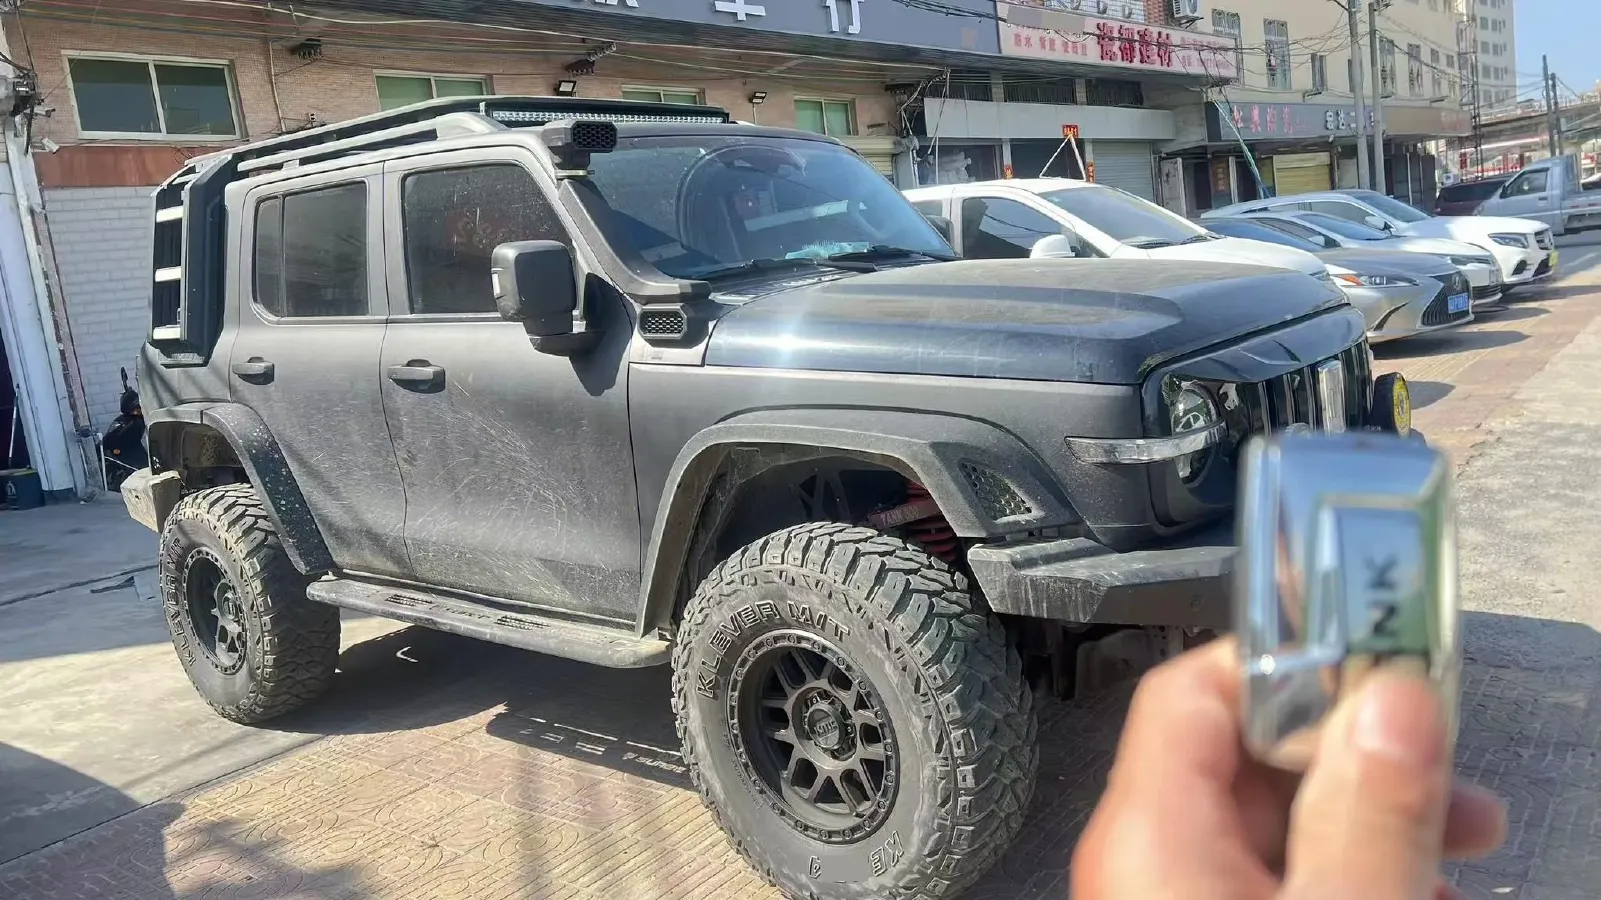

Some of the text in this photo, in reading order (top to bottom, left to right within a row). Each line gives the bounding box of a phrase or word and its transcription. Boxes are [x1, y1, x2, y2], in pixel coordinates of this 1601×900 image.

[880, 508, 903, 527] TANK
[165, 573, 197, 667] KLEVER
[697, 600, 851, 698] KLEVER M/T
